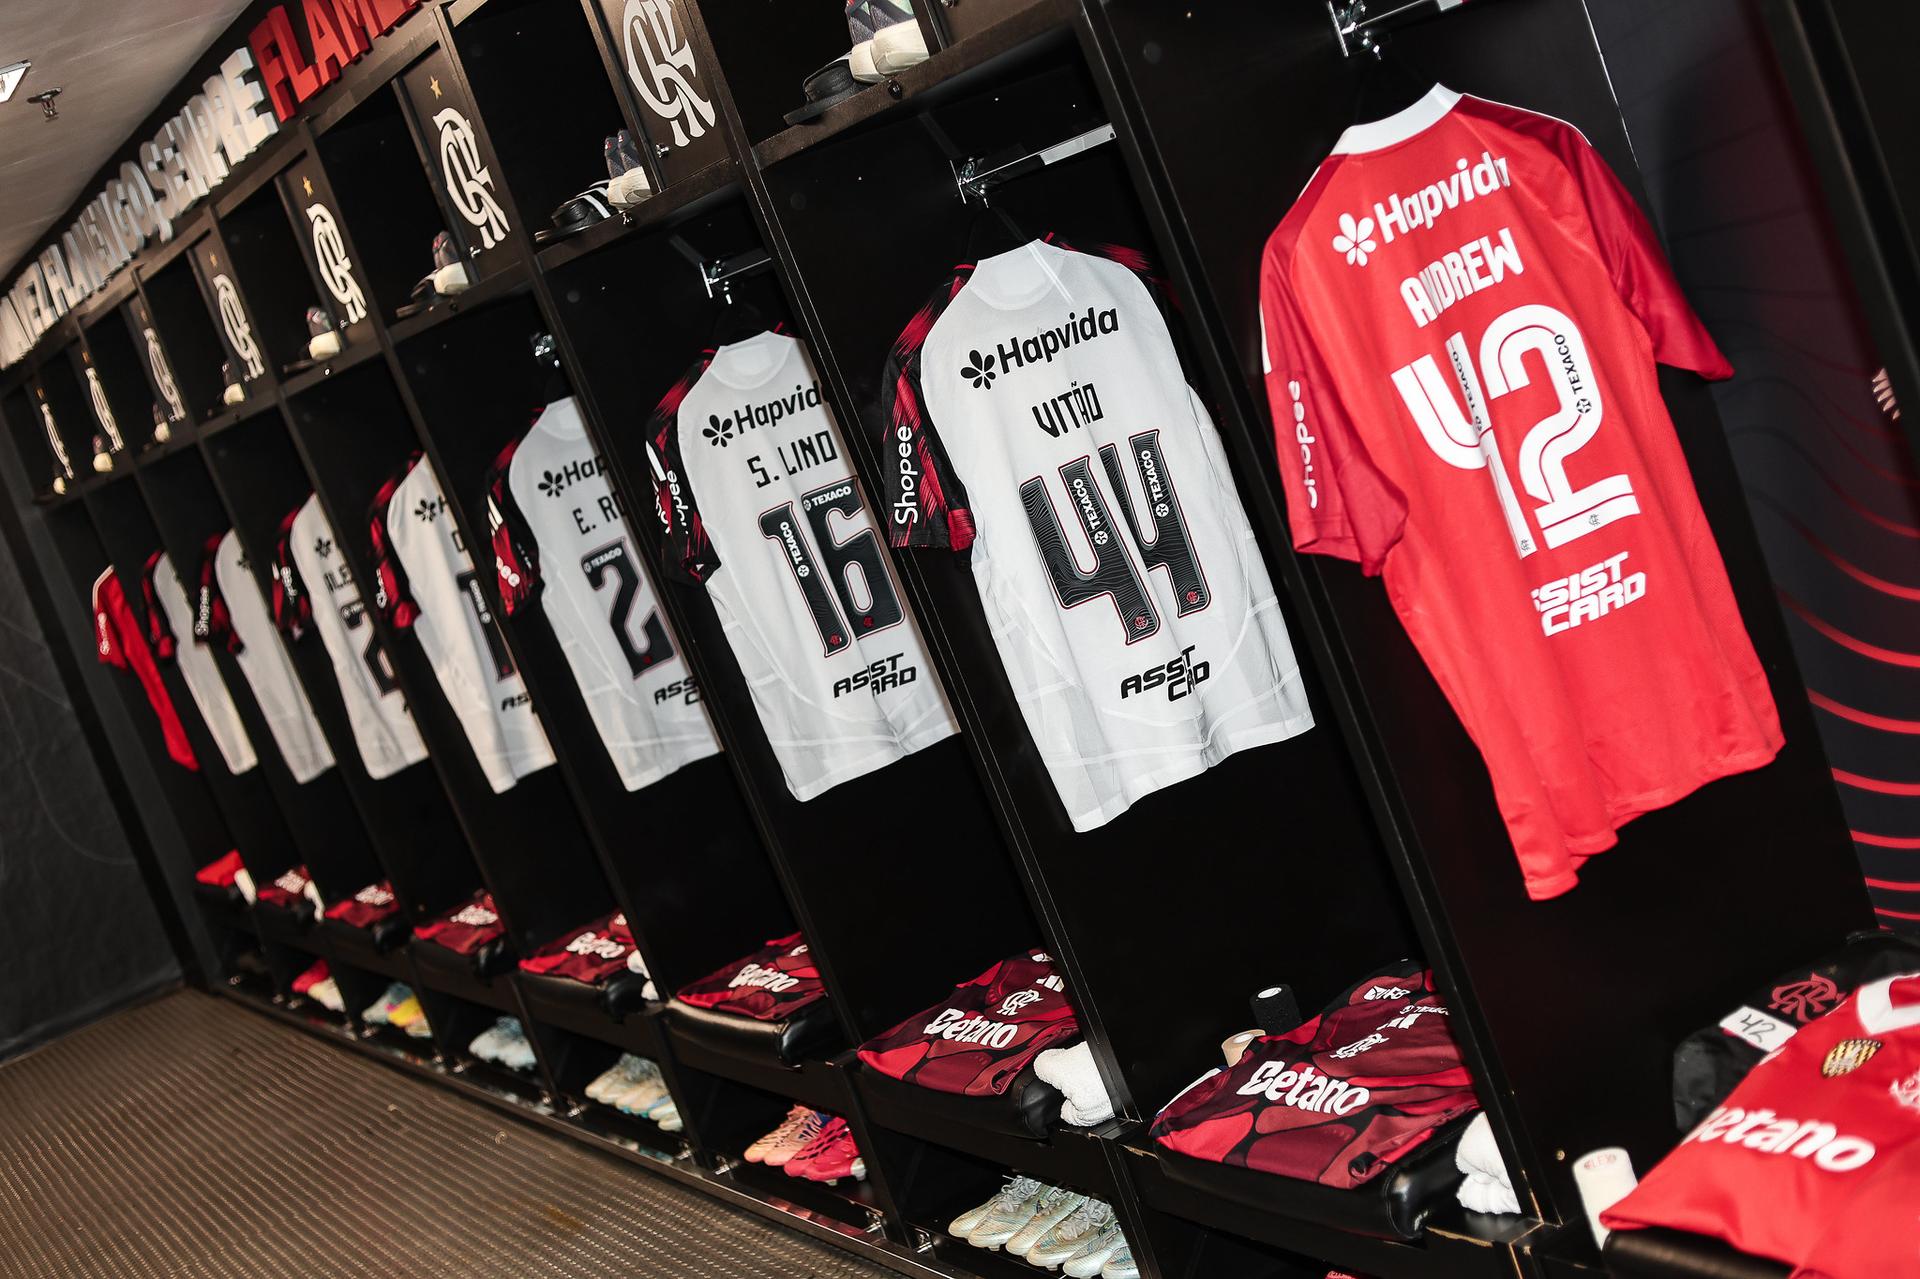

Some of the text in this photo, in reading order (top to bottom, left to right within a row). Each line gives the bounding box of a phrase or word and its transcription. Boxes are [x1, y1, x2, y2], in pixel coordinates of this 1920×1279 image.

[996, 307, 1119, 374] Hapvida
[1554, 334, 1584, 395] TEXACO
[734, 380, 824, 434] Hapvid
[1032, 380, 1104, 438] VITÃO
[1391, 303, 1641, 560] 42
[747, 430, 838, 488] S. LINO
[894, 425, 921, 526] Shopee
[1141, 449, 1164, 502] TEXACO
[811, 486, 852, 507] TEXACO
[1072, 478, 1102, 531] TEXACO
[779, 521, 803, 565] TEXACO
[1018, 428, 1211, 646] 44
[758, 475, 906, 658] 16
[1530, 551, 1629, 613] SIST
[581, 536, 681, 681] 2
[1541, 571, 1646, 637] CARD
[870, 666, 917, 697] ARD
[923, 1008, 1019, 1049] Betano
[1739, 1013, 1777, 1044] 42
[1236, 1060, 1370, 1116] Betano
[1680, 1106, 1877, 1173] etano
